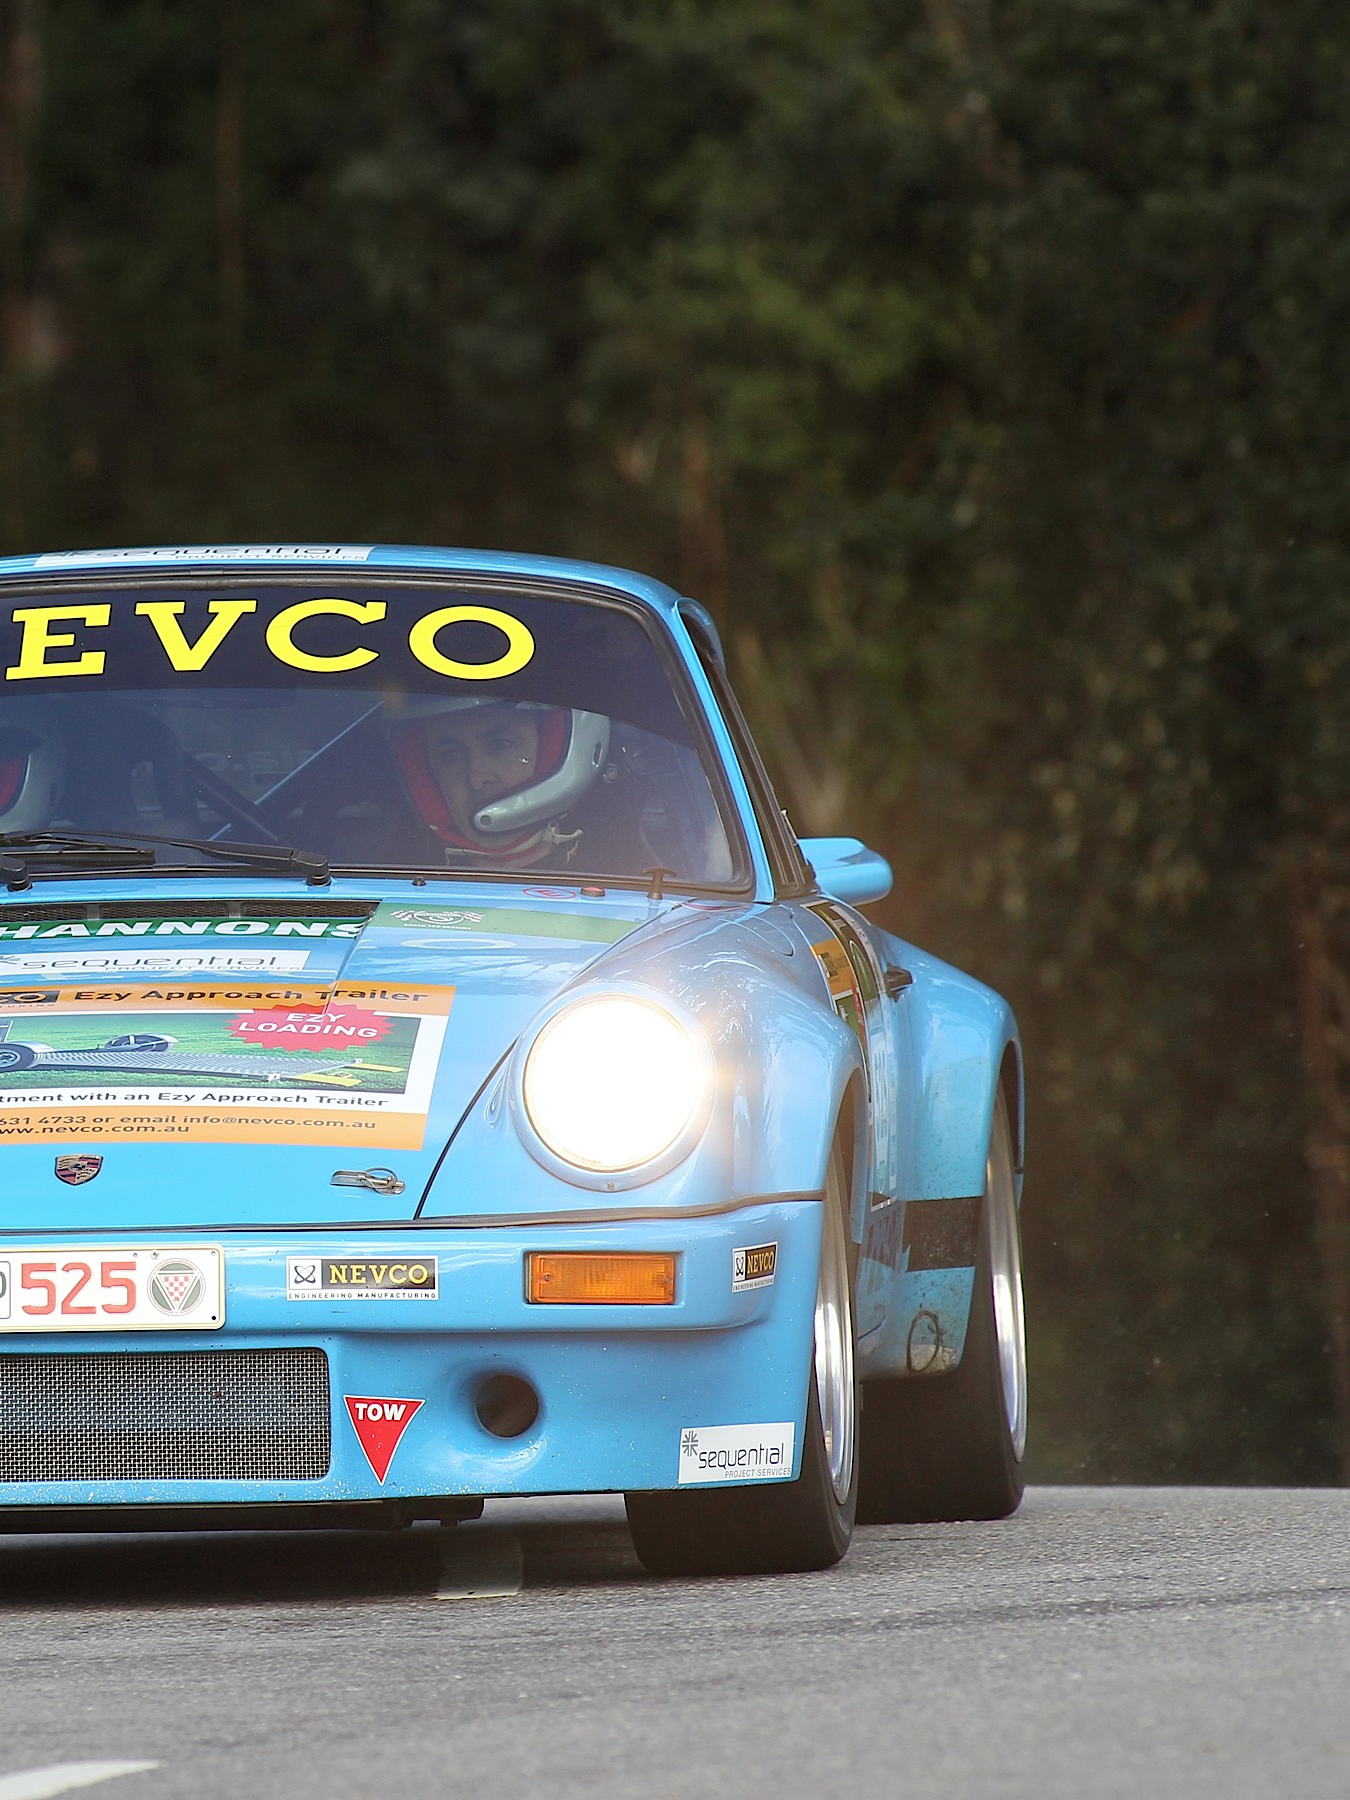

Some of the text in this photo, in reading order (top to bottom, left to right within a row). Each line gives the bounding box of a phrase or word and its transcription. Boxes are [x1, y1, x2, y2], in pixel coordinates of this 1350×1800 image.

[22, 955, 277, 969] sequential
[75, 991, 132, 1001] Ezy
[141, 990, 303, 1001] Approach
[315, 988, 429, 1002] Trailer
[286, 1013, 346, 1023] EZY
[238, 1022, 378, 1038] LOADING
[71, 1091, 117, 1101] with
[124, 1092, 151, 1101] an
[158, 1092, 194, 1102] Ezy
[201, 1092, 308, 1104] Approach
[315, 1095, 389, 1107] Trailer
[38, 1115, 87, 1125] 4733
[92, 1115, 115, 1124] or
[120, 1115, 178, 1124] email
[183, 1115, 376, 1129] info@nevco.com.au
[747, 1251, 775, 1274] NEVCO
[329, 1264, 429, 1285] NEVCO
[21, 1262, 137, 1315] 525
[288, 1292, 353, 1300] ENGINEERING
[355, 1403, 407, 1421] TOW
[698, 1442, 784, 1470] sequential
[724, 1467, 791, 1479] PROJECT SERVICES
